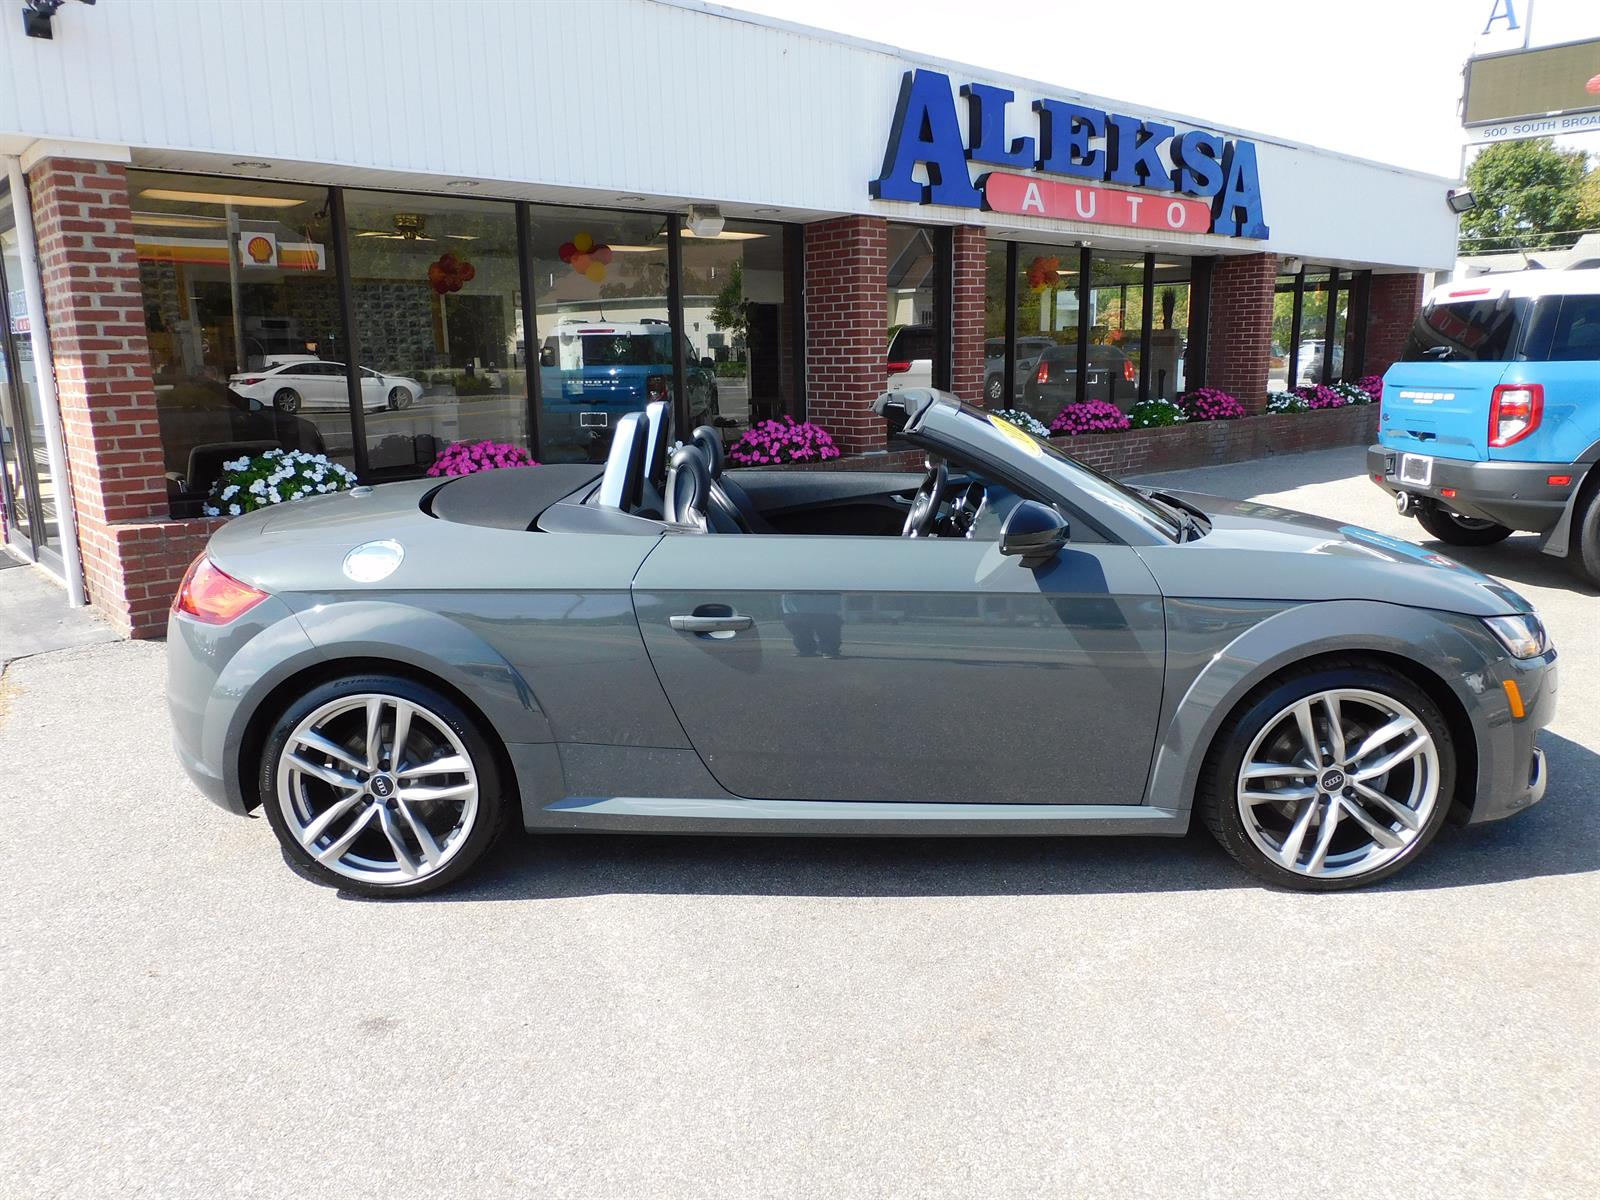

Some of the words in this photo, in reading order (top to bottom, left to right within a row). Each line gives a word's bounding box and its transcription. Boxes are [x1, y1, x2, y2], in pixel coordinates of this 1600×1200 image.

[1481, 0, 1521, 35] A
[1483, 127, 1508, 138] 500
[1513, 121, 1556, 134] SOUTH
[1562, 115, 1600, 128] BROA
[869, 67, 1270, 241] ALEKSA
[1022, 182, 1187, 230] AUTO
